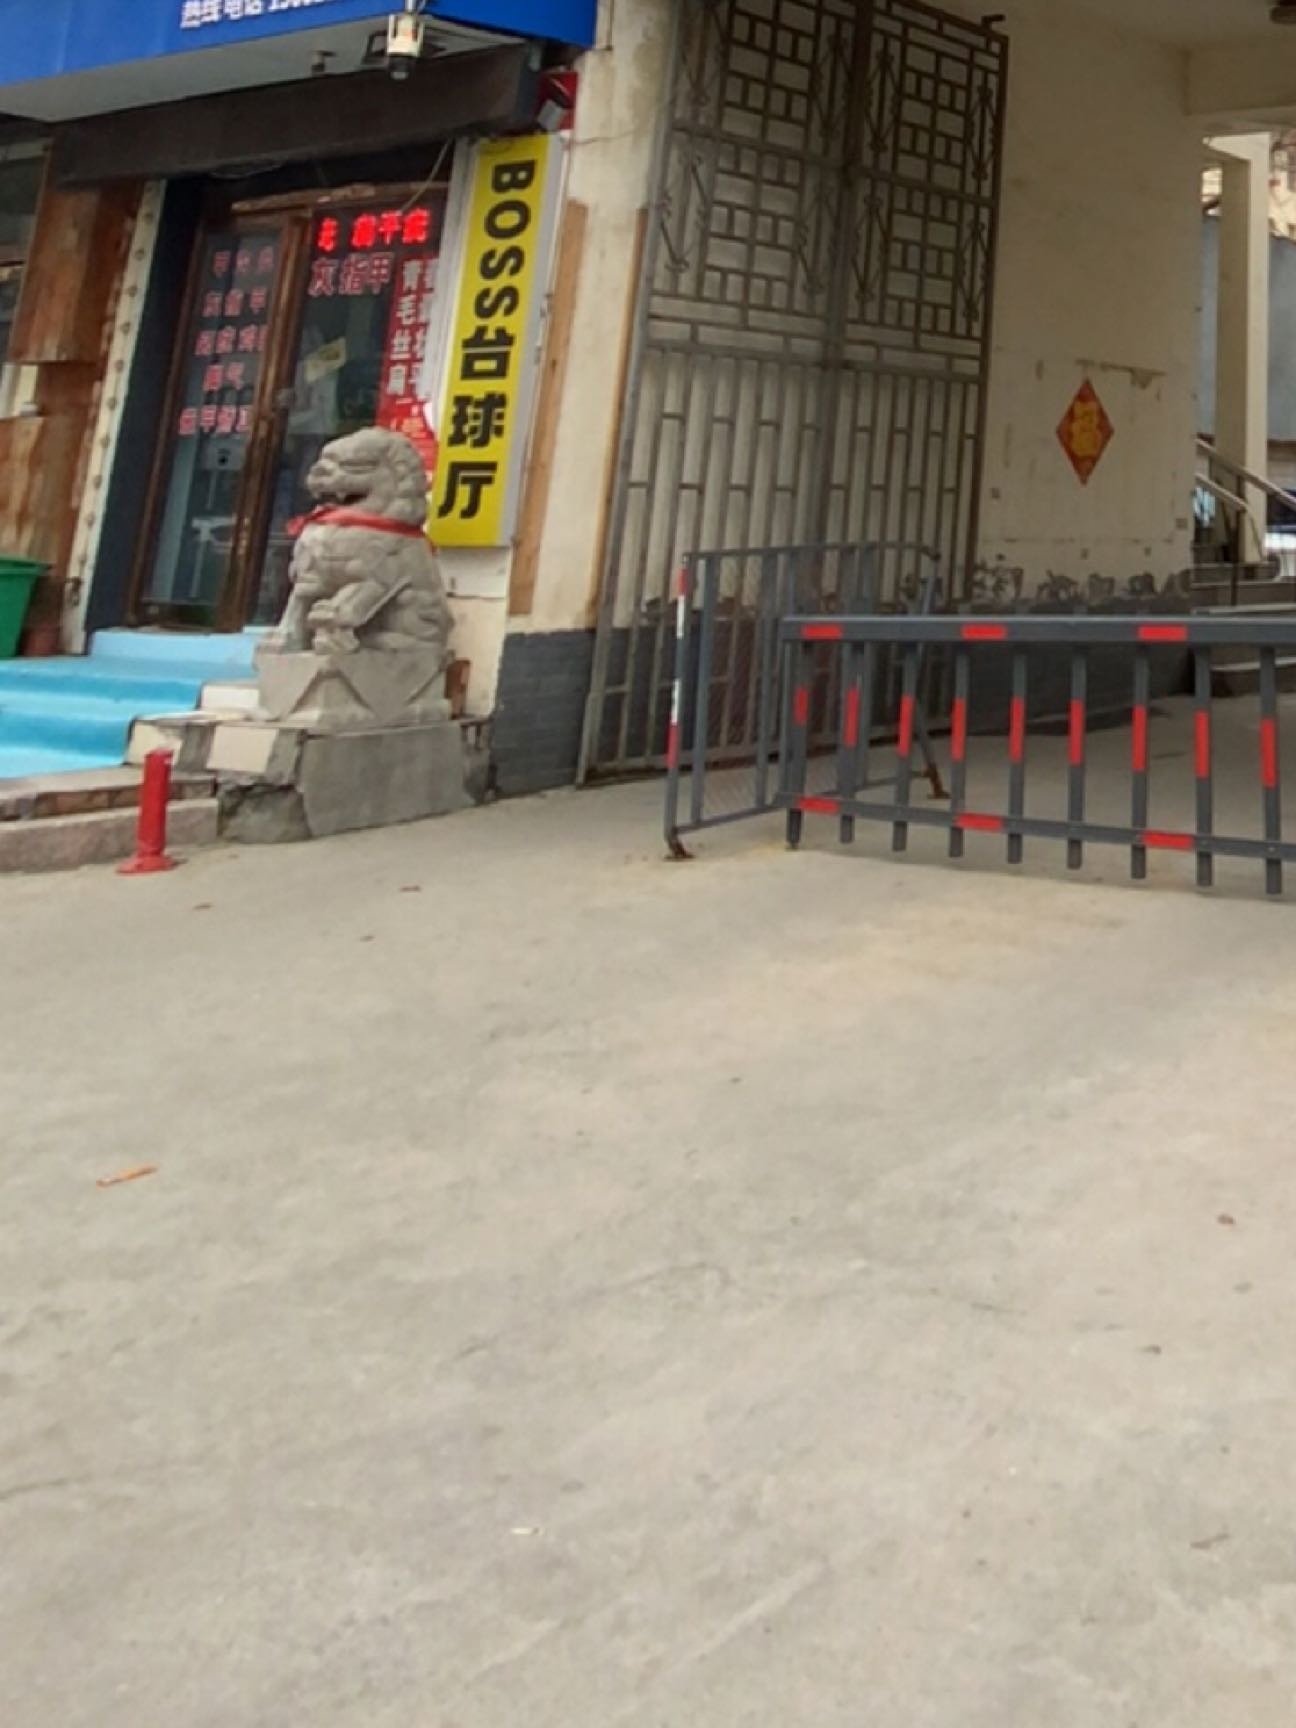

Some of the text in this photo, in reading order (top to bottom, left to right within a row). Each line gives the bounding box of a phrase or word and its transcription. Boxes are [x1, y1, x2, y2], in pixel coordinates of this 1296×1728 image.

[308, 252, 394, 297] 灰指甲
[438, 158, 537, 520] BOSS台球厅
